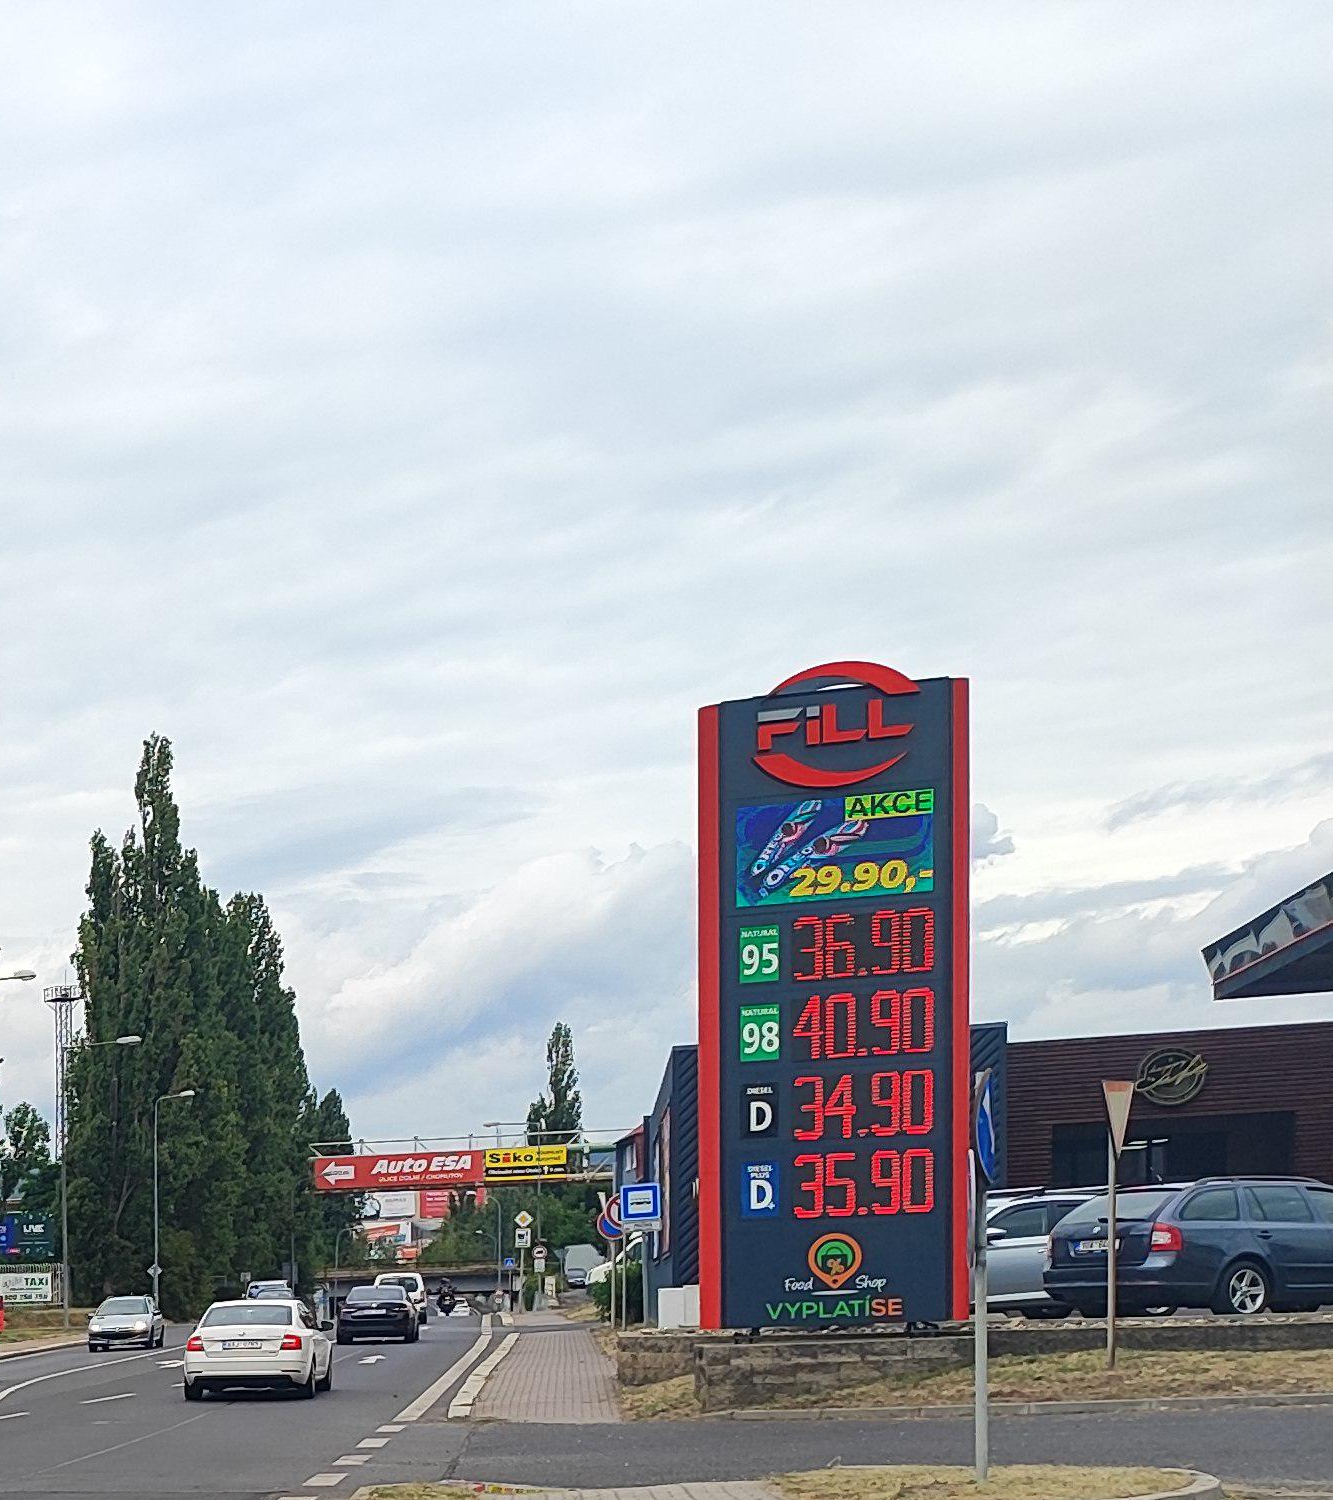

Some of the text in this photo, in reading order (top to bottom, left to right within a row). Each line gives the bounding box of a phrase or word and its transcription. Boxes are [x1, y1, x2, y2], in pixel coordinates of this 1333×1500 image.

[848, 791, 932, 817] AKCE
[742, 943, 779, 977] 95
[793, 907, 935, 981] 36.90
[742, 1021, 780, 1055] 98
[793, 987, 935, 1060] 40.90
[750, 1100, 773, 1132] D
[793, 1070, 934, 1141] 34.90
[429, 1155, 472, 1172] ESA
[793, 1149, 935, 1219] 35.90
[784, 1275, 887, 1293] Food Shop
